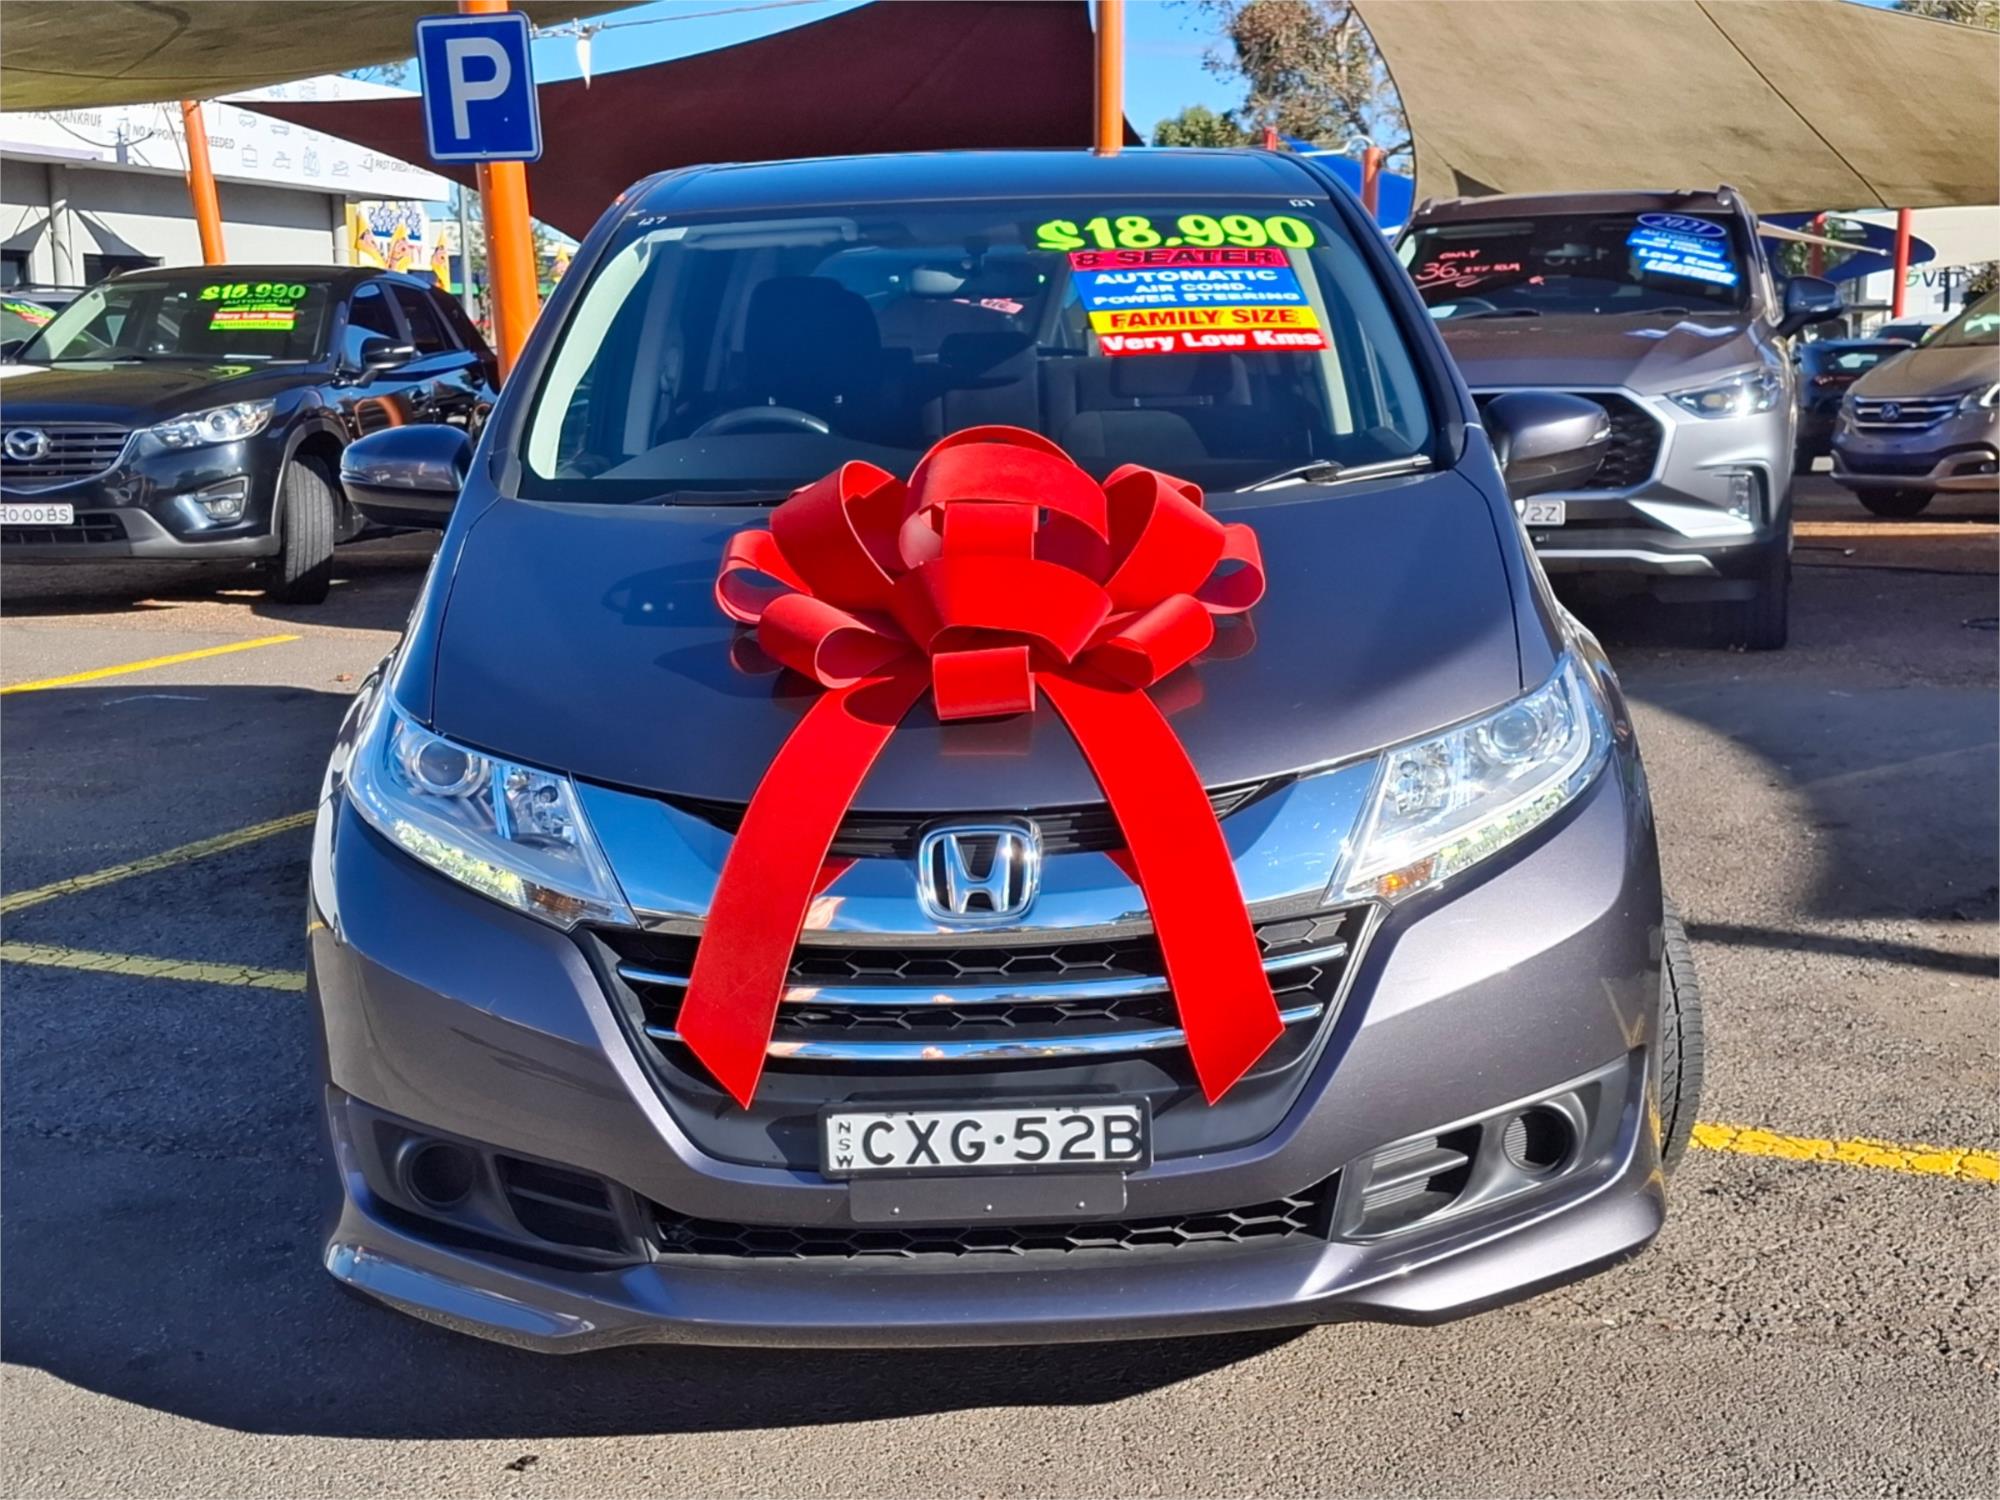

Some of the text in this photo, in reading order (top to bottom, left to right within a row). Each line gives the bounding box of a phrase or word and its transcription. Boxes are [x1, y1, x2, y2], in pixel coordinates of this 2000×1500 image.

[446, 37, 511, 139] P
[1037, 214, 1315, 250] $18.990
[1651, 216, 1712, 232] 2021
[1076, 250, 1274, 267] 8 SEATER
[1095, 270, 1278, 285] AUTOMATIC
[1135, 283, 1175, 293] AIR
[1093, 291, 1301, 305] POWER STEERING
[1110, 308, 1298, 328] FAMILY SIZE
[1101, 328, 1323, 352] Very Low Kms
